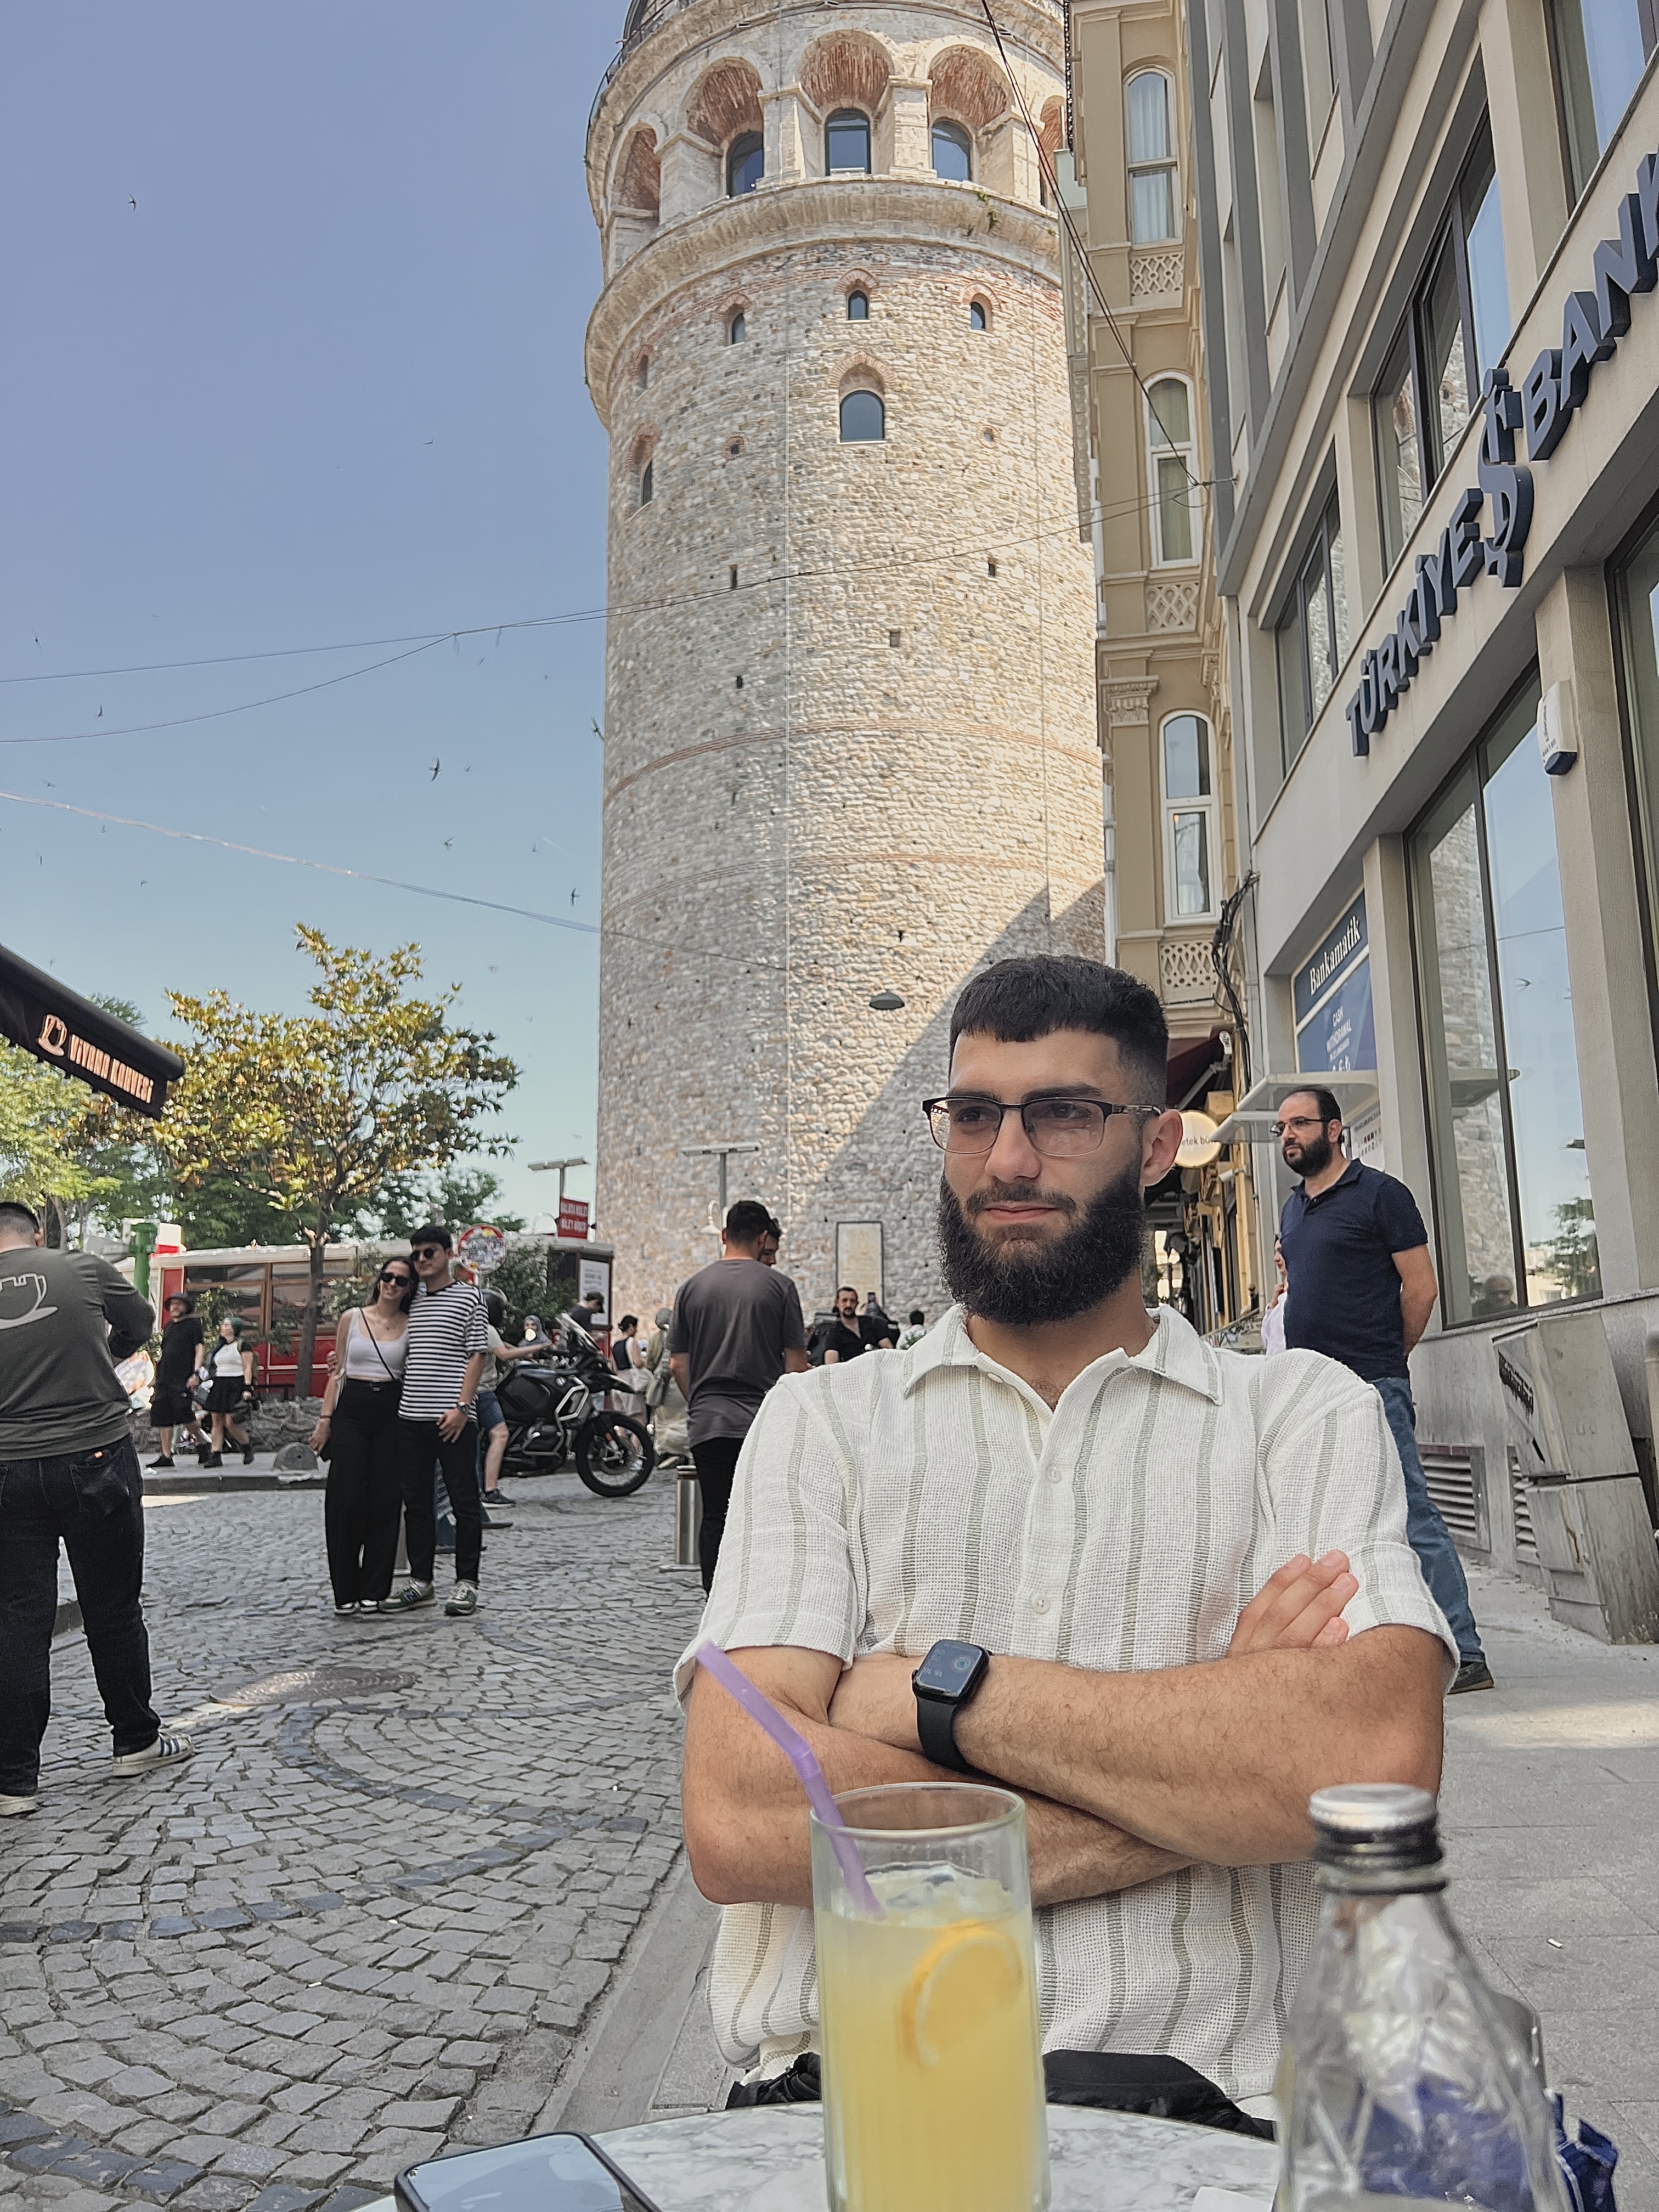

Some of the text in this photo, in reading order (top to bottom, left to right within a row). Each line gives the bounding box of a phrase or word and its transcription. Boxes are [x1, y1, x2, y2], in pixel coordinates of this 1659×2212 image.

[1346, 488, 1483, 756] TÜRKİYE
[1309, 915, 1361, 996] Bankamatik
[1181, 1136, 1198, 1147] etek
